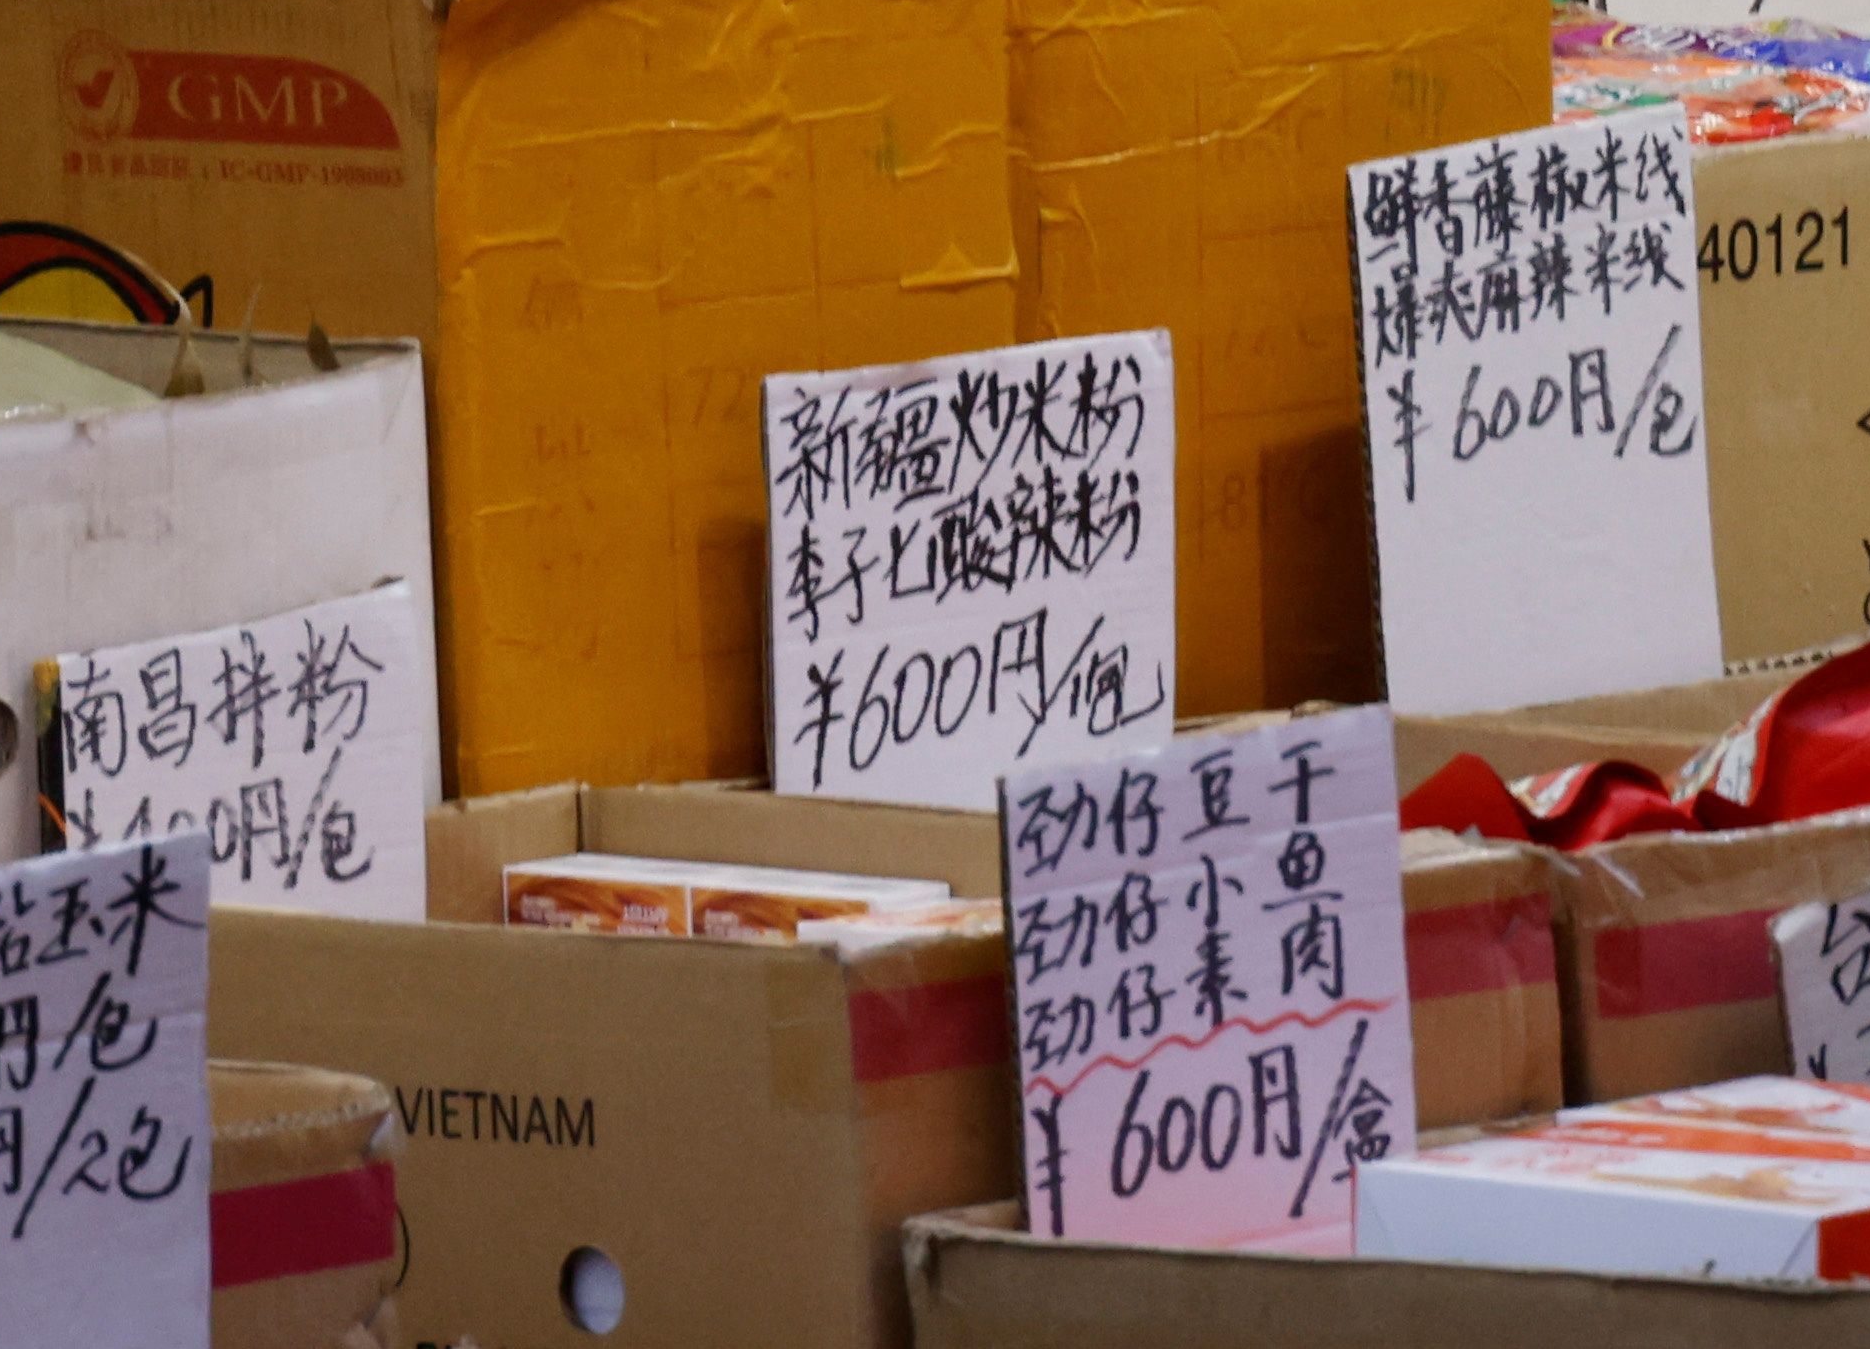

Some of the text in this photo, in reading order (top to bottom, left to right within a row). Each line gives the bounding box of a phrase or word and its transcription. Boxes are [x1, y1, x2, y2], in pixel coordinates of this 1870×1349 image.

[166, 72, 350, 129] GMP
[1696, 204, 1853, 282] 40121
[1385, 323, 1701, 503] ¥600円/包
[394, 1085, 596, 1148] VIETNAM
